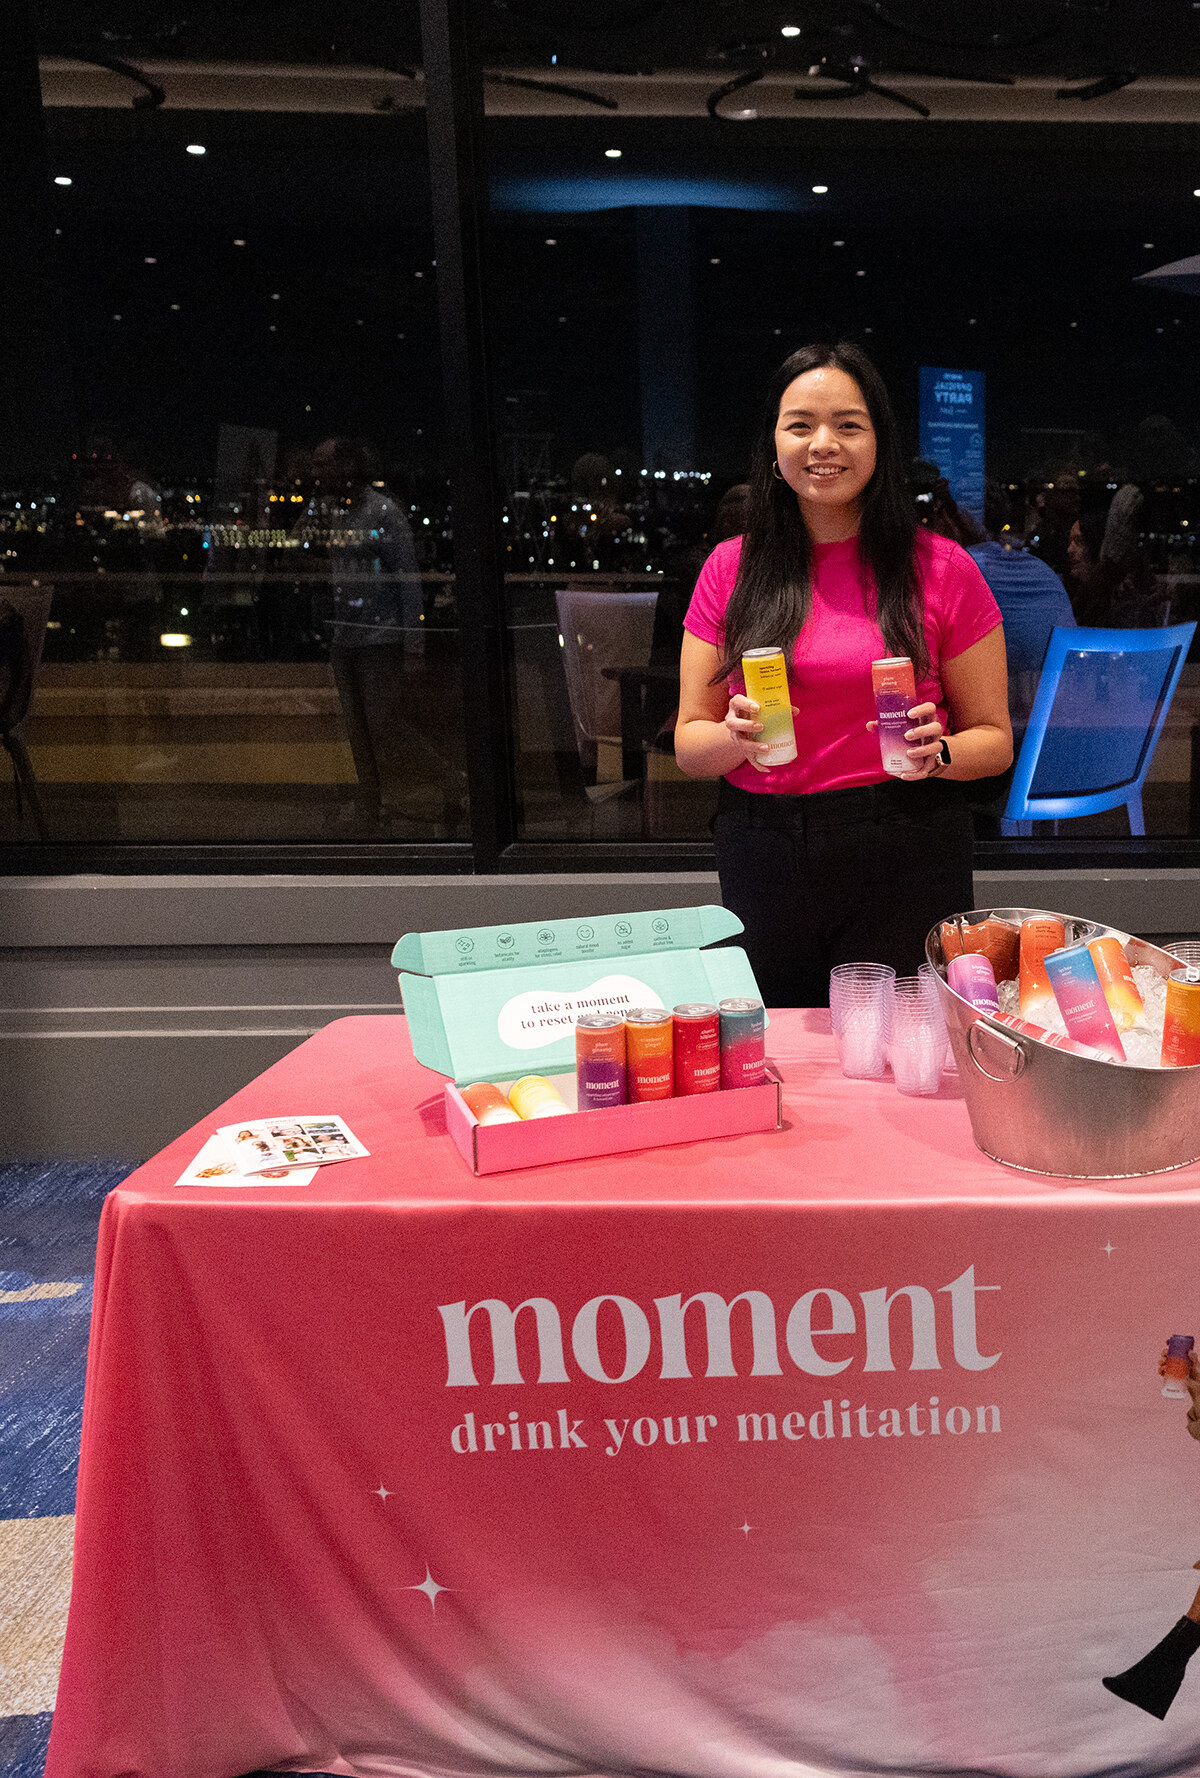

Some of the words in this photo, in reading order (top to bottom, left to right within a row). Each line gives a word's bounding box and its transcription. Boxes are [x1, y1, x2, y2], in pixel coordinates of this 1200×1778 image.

[879, 710, 906, 719] moment
[530, 1002, 561, 1014] take
[564, 1002, 573, 1011] a
[576, 994, 630, 1009] moment
[1065, 1000, 1095, 1016] moment
[520, 1019, 535, 1030] to
[539, 1015, 573, 1028] reset
[585, 1079, 620, 1090] moment
[637, 1073, 670, 1084] moment
[437, 1264, 1003, 1387] moment
[450, 1408, 588, 1454] drink
[605, 1411, 718, 1456] your
[737, 1396, 1002, 1443] meditation
